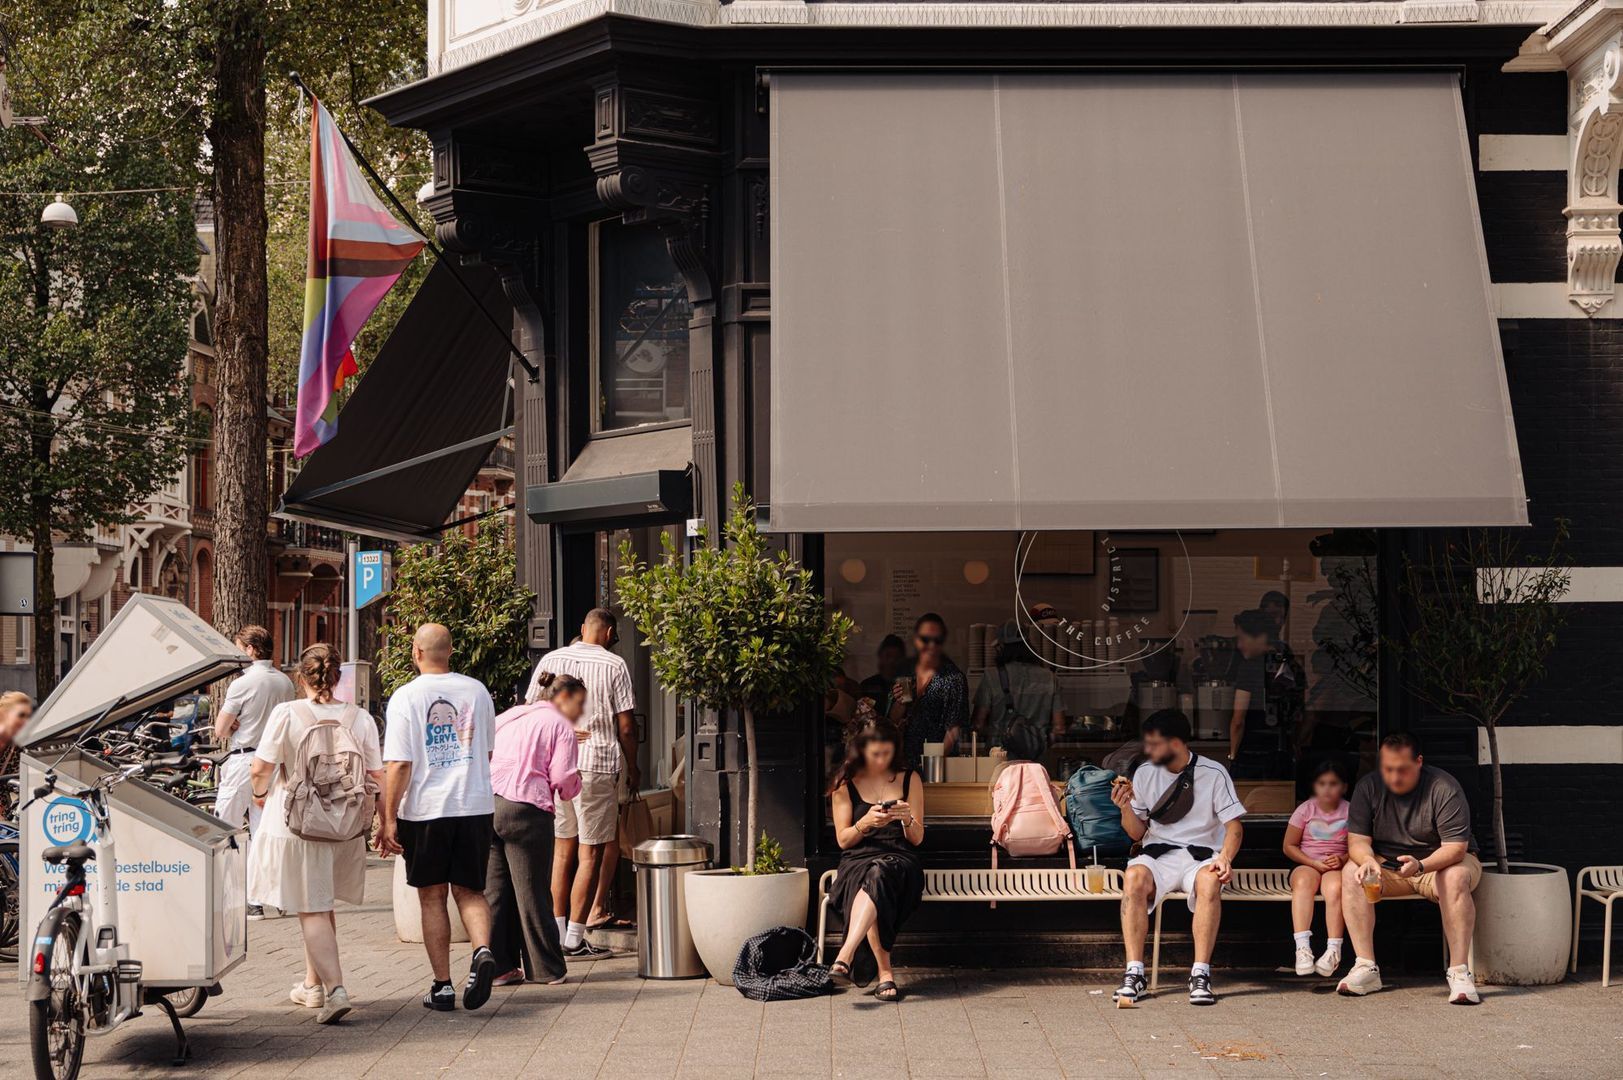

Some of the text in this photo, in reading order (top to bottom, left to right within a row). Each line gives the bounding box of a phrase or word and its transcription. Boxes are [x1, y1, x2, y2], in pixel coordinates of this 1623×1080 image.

[363, 567, 374, 589] P
[1101, 537, 1122, 612] DISTRICT
[1058, 616, 1150, 646] THE COFFEE
[426, 723, 453, 743] SOFT
[50, 811, 76, 823] tring
[53, 822, 79, 834] tring
[135, 879, 164, 892] stad
